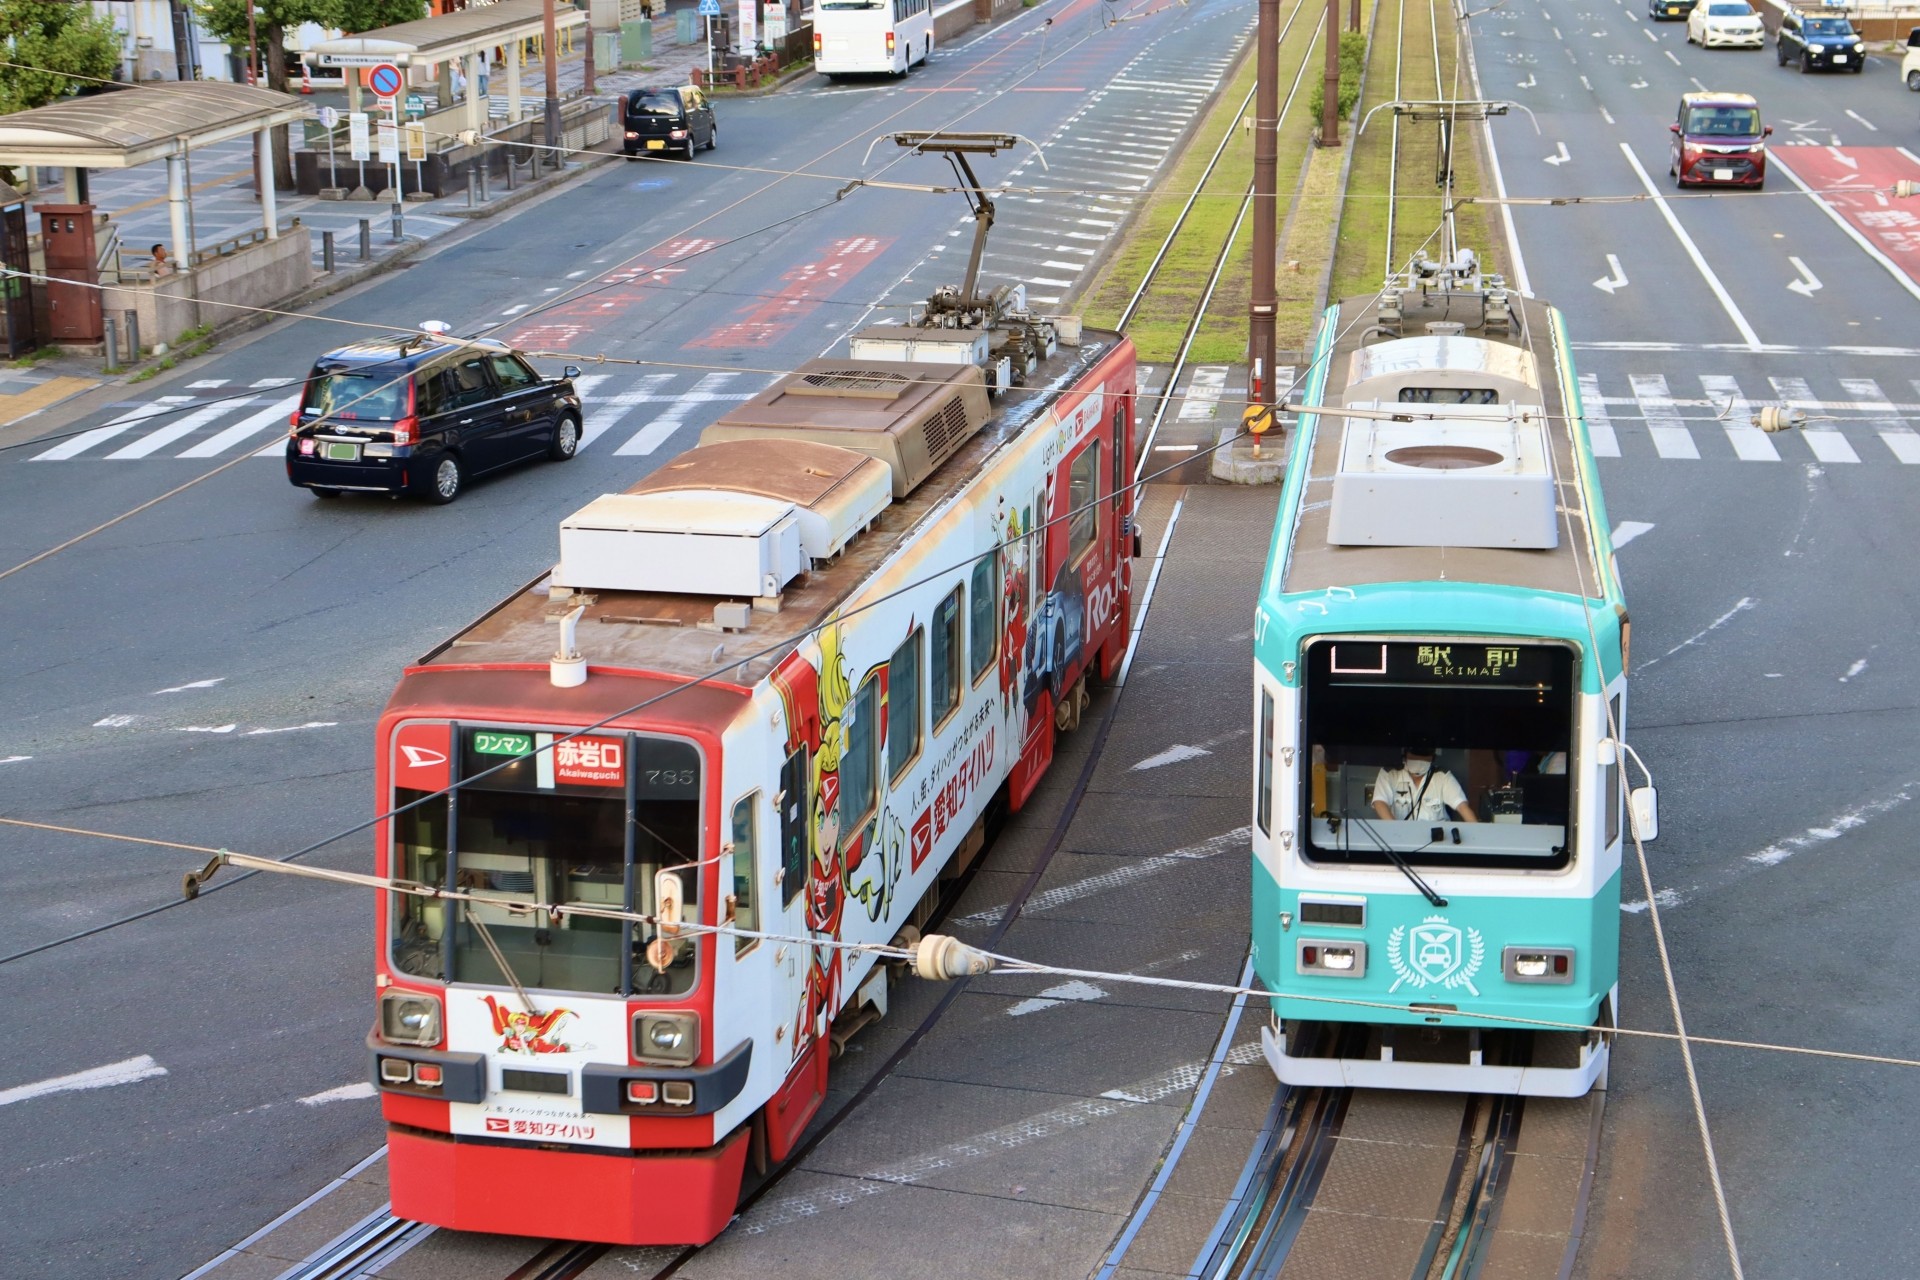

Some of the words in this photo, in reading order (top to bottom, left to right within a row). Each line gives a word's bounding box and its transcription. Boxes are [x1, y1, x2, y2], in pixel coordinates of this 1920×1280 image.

[1434, 666, 1501, 677] EKIMAE
[476, 734, 529, 754] ワンマン
[556, 738, 621, 769] 赤岩口
[558, 767, 620, 781] Akaiwaguchi
[645, 769, 695, 786] 785
[934, 724, 995, 845] 愛知ダイハツ
[513, 1119, 596, 1140] 愛知ダイハツ
